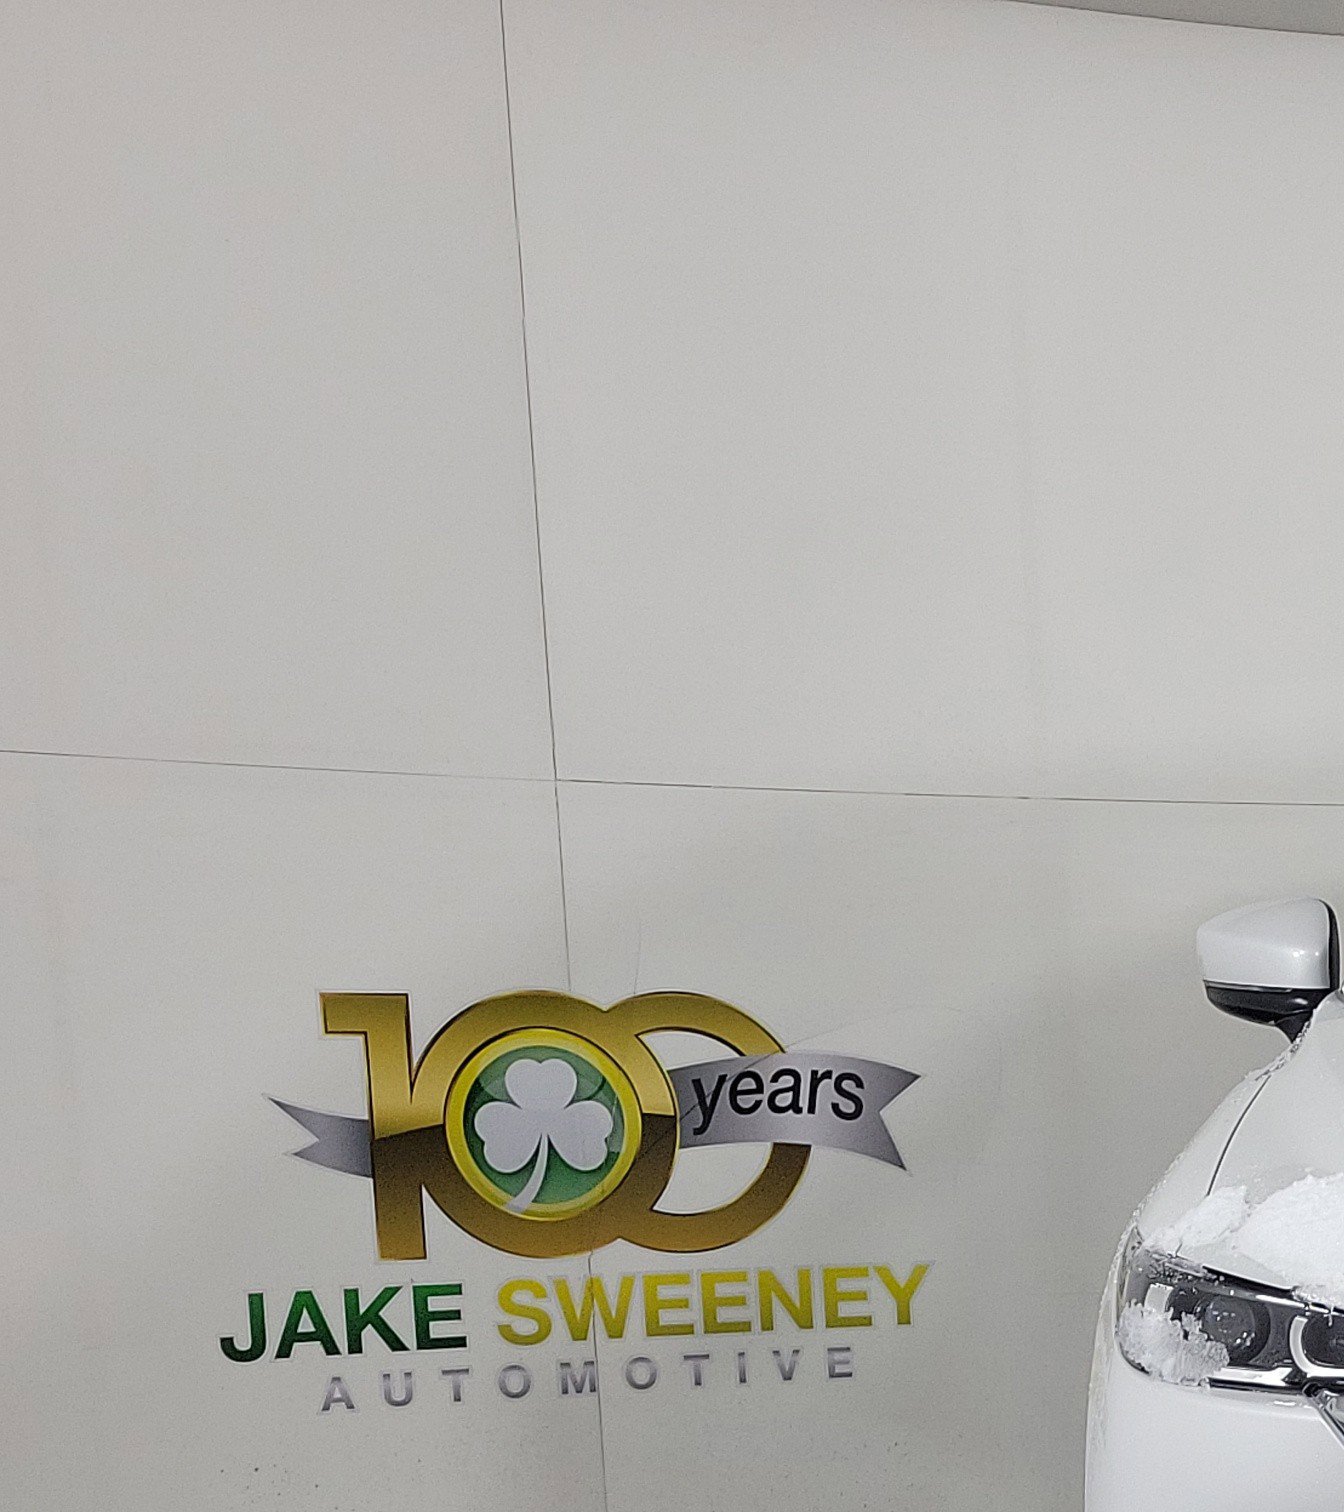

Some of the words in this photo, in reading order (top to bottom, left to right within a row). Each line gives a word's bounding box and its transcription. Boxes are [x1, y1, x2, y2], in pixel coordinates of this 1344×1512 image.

[318, 989, 812, 1260] 100
[692, 1067, 866, 1134] years
[219, 1284, 467, 1362] JAKE
[497, 1263, 930, 1347] SWEENEY
[321, 1346, 855, 1413] AUTOMOTIVE
